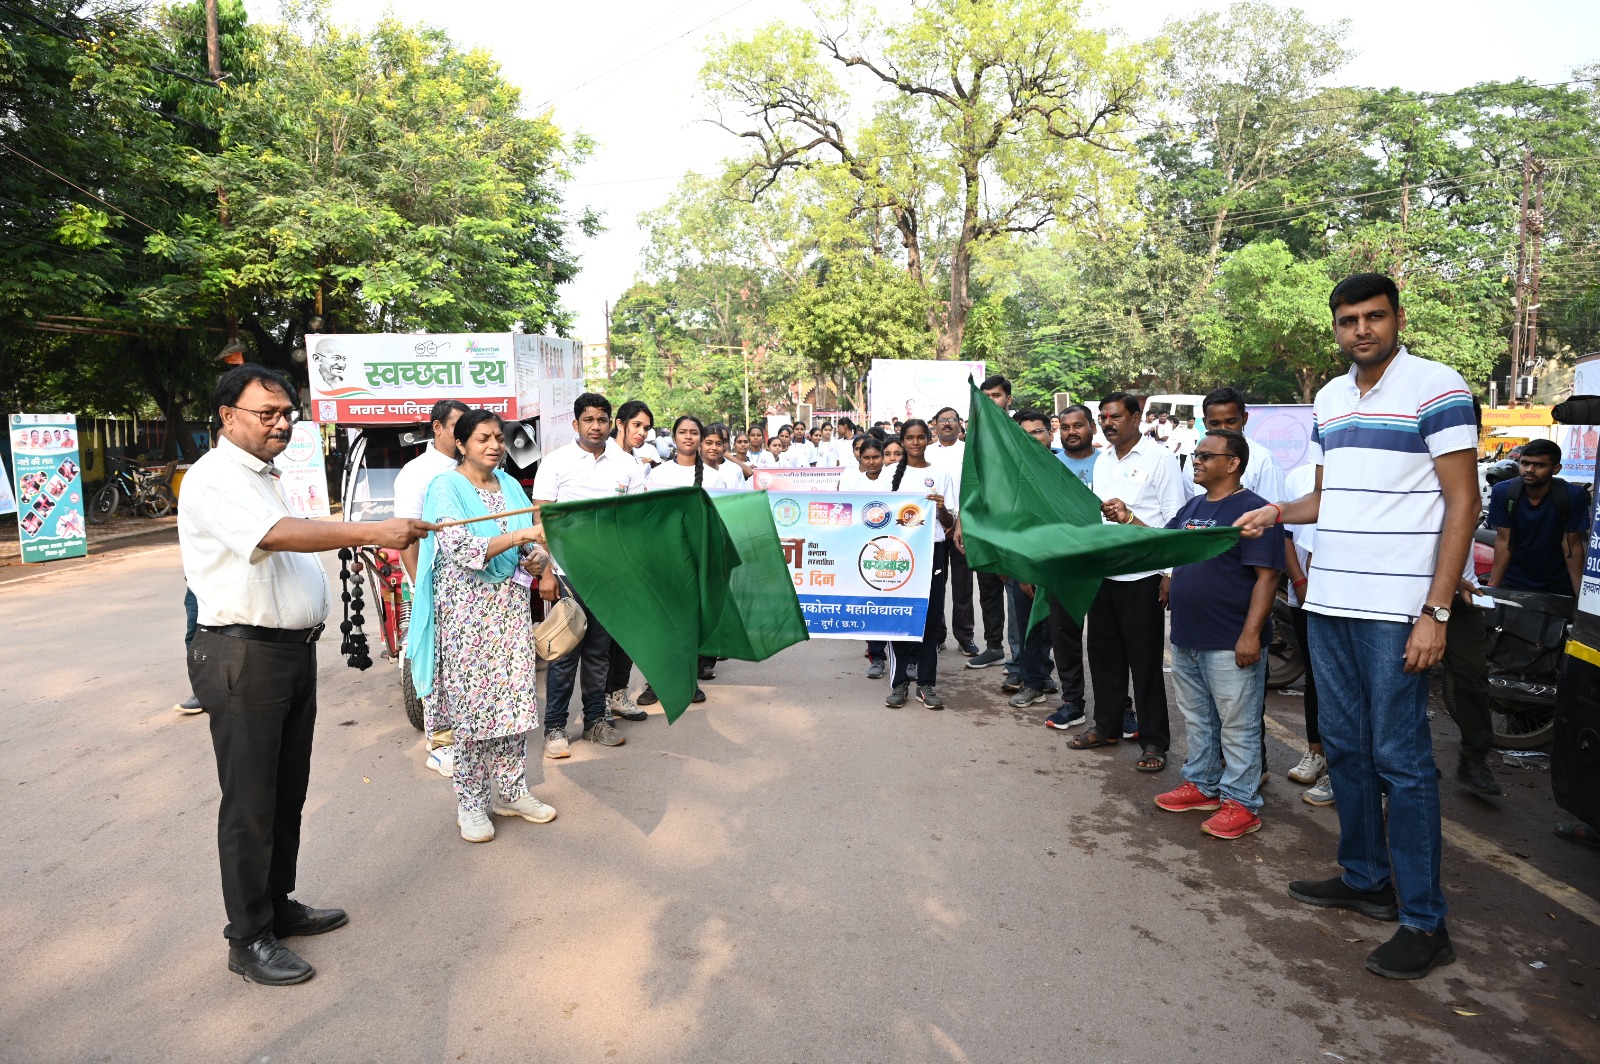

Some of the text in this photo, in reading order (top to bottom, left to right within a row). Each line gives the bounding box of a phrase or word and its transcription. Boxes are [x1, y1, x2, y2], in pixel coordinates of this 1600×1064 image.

[363, 360, 507, 387] स्वच्छता रथ
[348, 404, 386, 415] नगर
[483, 399, 509, 414] दर्ग
[31, 456, 40, 466] की
[809, 510, 829, 519] रजत
[807, 541, 819, 549] सेवा
[793, 570, 836, 587] 5 दिन
[845, 600, 914, 616] महाविद्यालय
